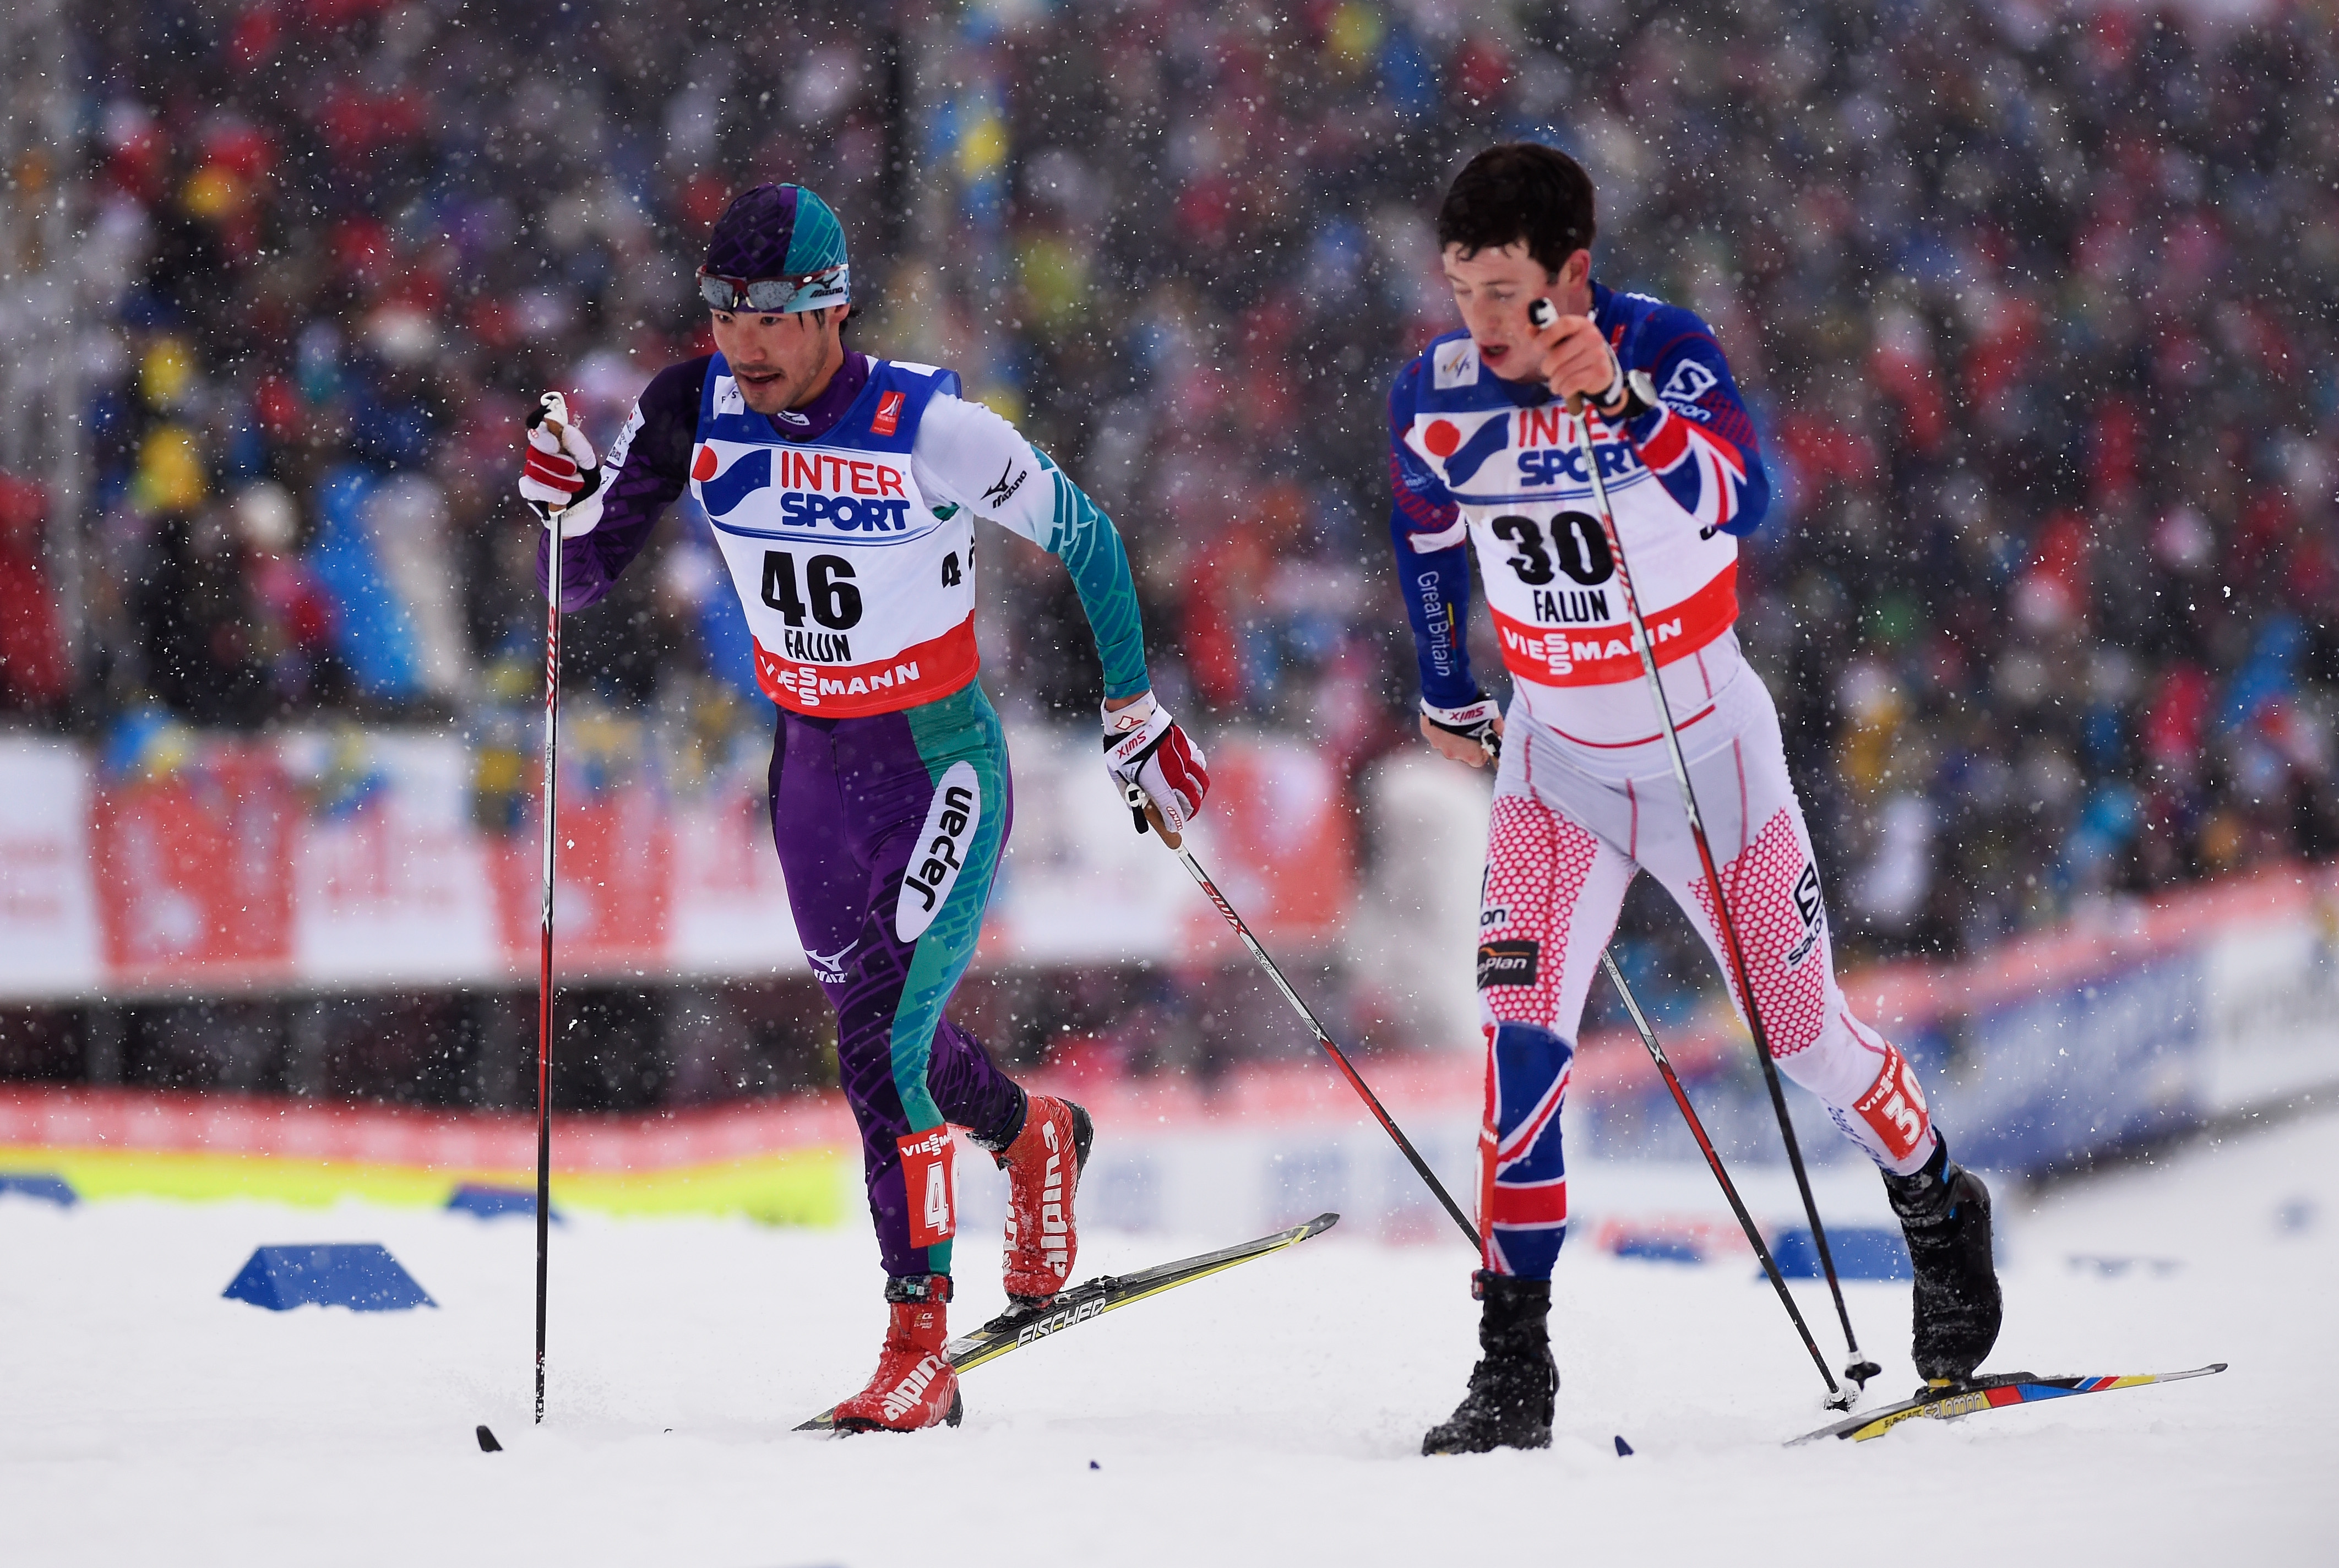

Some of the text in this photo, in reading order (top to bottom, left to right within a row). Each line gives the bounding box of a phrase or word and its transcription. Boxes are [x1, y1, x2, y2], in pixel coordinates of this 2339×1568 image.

[1519, 403, 1630, 448] INE
[780, 492, 912, 531] SPORT
[781, 450, 907, 498] INTER
[1492, 510, 1615, 586] 30
[760, 550, 863, 631] 46
[1417, 571, 1454, 677] Great Britain
[1533, 589, 1609, 622] FALUN
[784, 629, 852, 662] FALUN
[905, 786, 973, 912] Japan
[1881, 1063, 1928, 1146] 30
[1040, 1120, 1068, 1278] alpina
